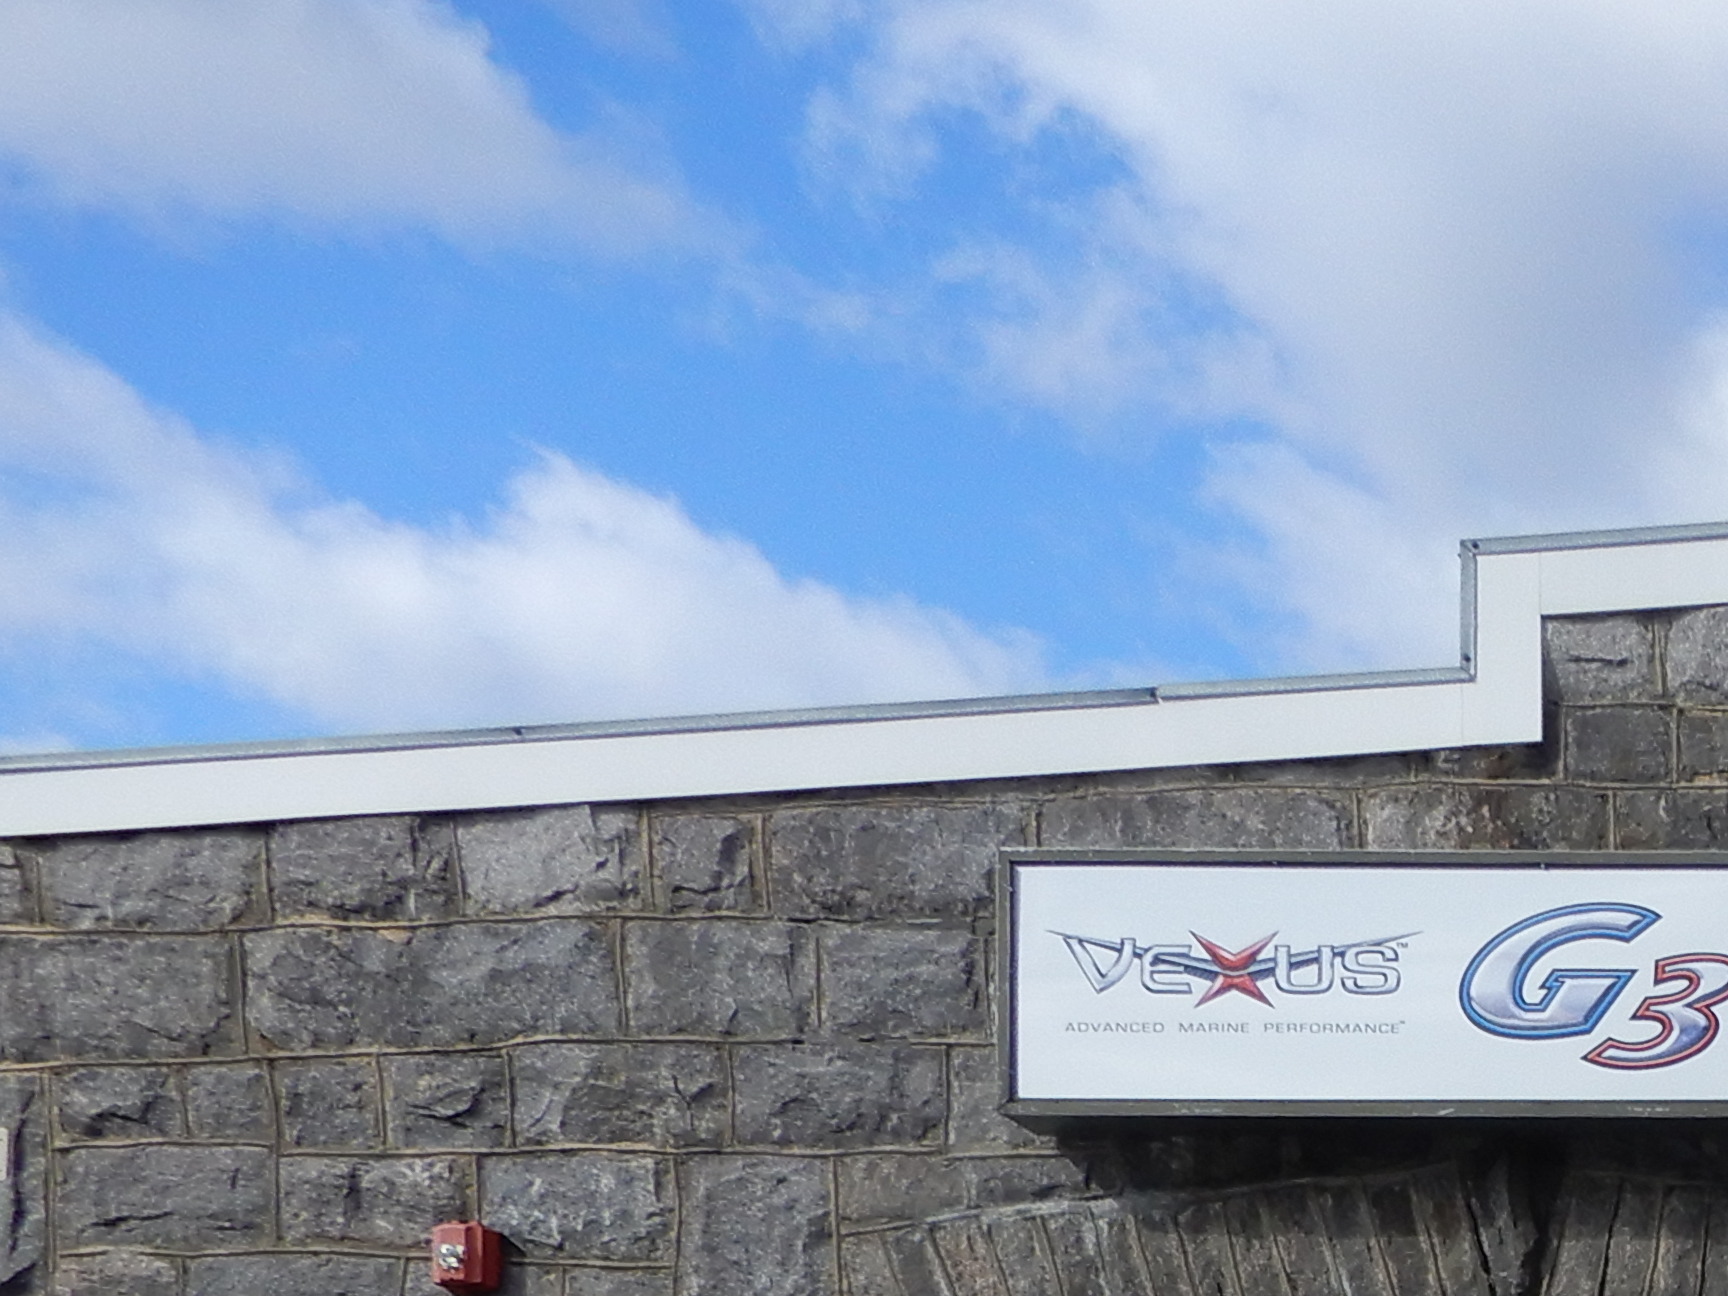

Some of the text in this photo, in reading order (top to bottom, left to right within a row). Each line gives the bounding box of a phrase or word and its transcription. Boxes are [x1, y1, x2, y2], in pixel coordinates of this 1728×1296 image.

[1058, 929, 1405, 1010] VEXUS
[1064, 1021, 1401, 1036] ADVANCED MARINE PERFORMANCE
